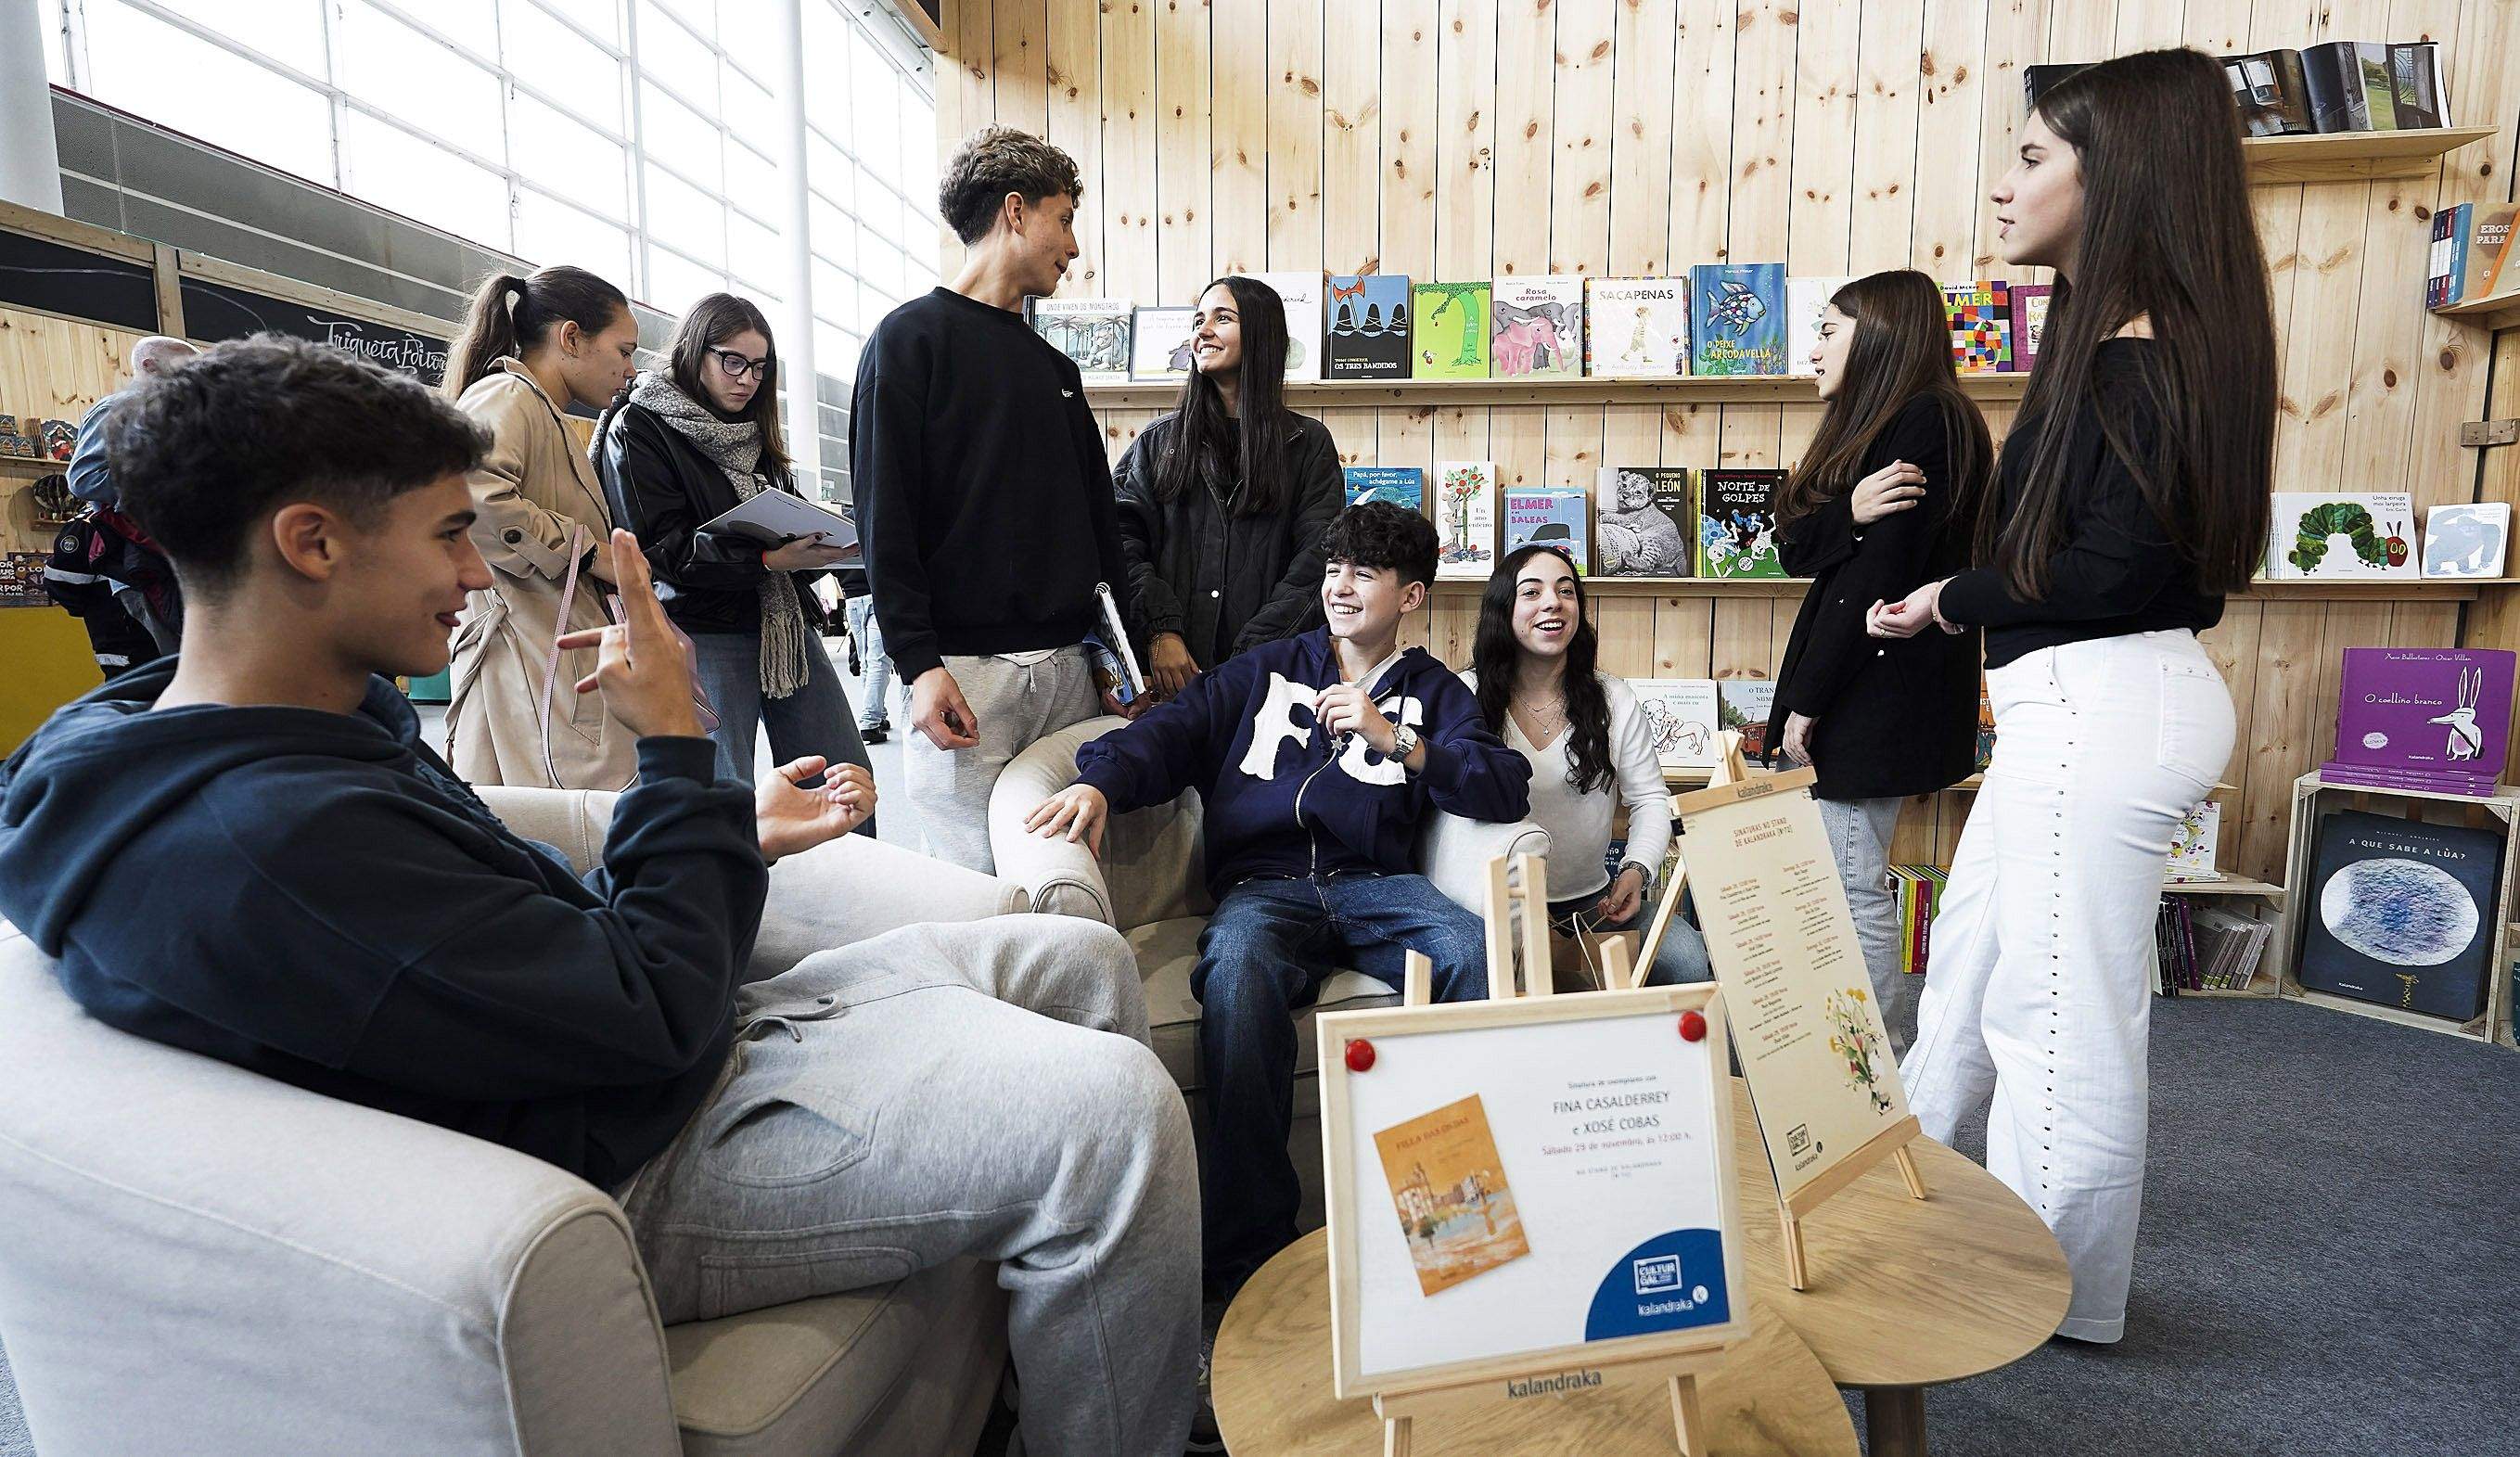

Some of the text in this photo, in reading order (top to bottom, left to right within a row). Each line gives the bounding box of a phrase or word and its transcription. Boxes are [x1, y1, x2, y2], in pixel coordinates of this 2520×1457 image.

[1599, 289, 1674, 300] SACAPENAS
[1943, 293, 1994, 306] LMER
[1046, 303, 1061, 312] ONDE
[1089, 302, 1119, 311] MONSTROS
[306, 314, 447, 375] Triqueta Editor
[1715, 339, 1735, 349] PEIXE
[1334, 362, 1398, 370] OS TRES BANDIDOS
[1656, 479, 1681, 492] LEÓN
[1717, 481, 1756, 492] NOITE
[1510, 498, 1554, 510] ELMER
[1721, 493, 1766, 504] GOLPES
[1511, 516, 1549, 524] BALEAS
[2364, 692, 2443, 706] O coelliño branco
[1771, 817, 1787, 827] STAND
[2361, 839, 2383, 849] QUE
[2388, 843, 2418, 853] SABE
[2437, 847, 2467, 860] LÚA?
[1553, 1090, 1670, 1113] FINA CASALDERREY
[1583, 1118, 1615, 1134] XOSÉ
[1619, 1115, 1660, 1131] COBAS
[1638, 1298, 1695, 1316] kalandraka
[1507, 1368, 1603, 1399] kalandraka
